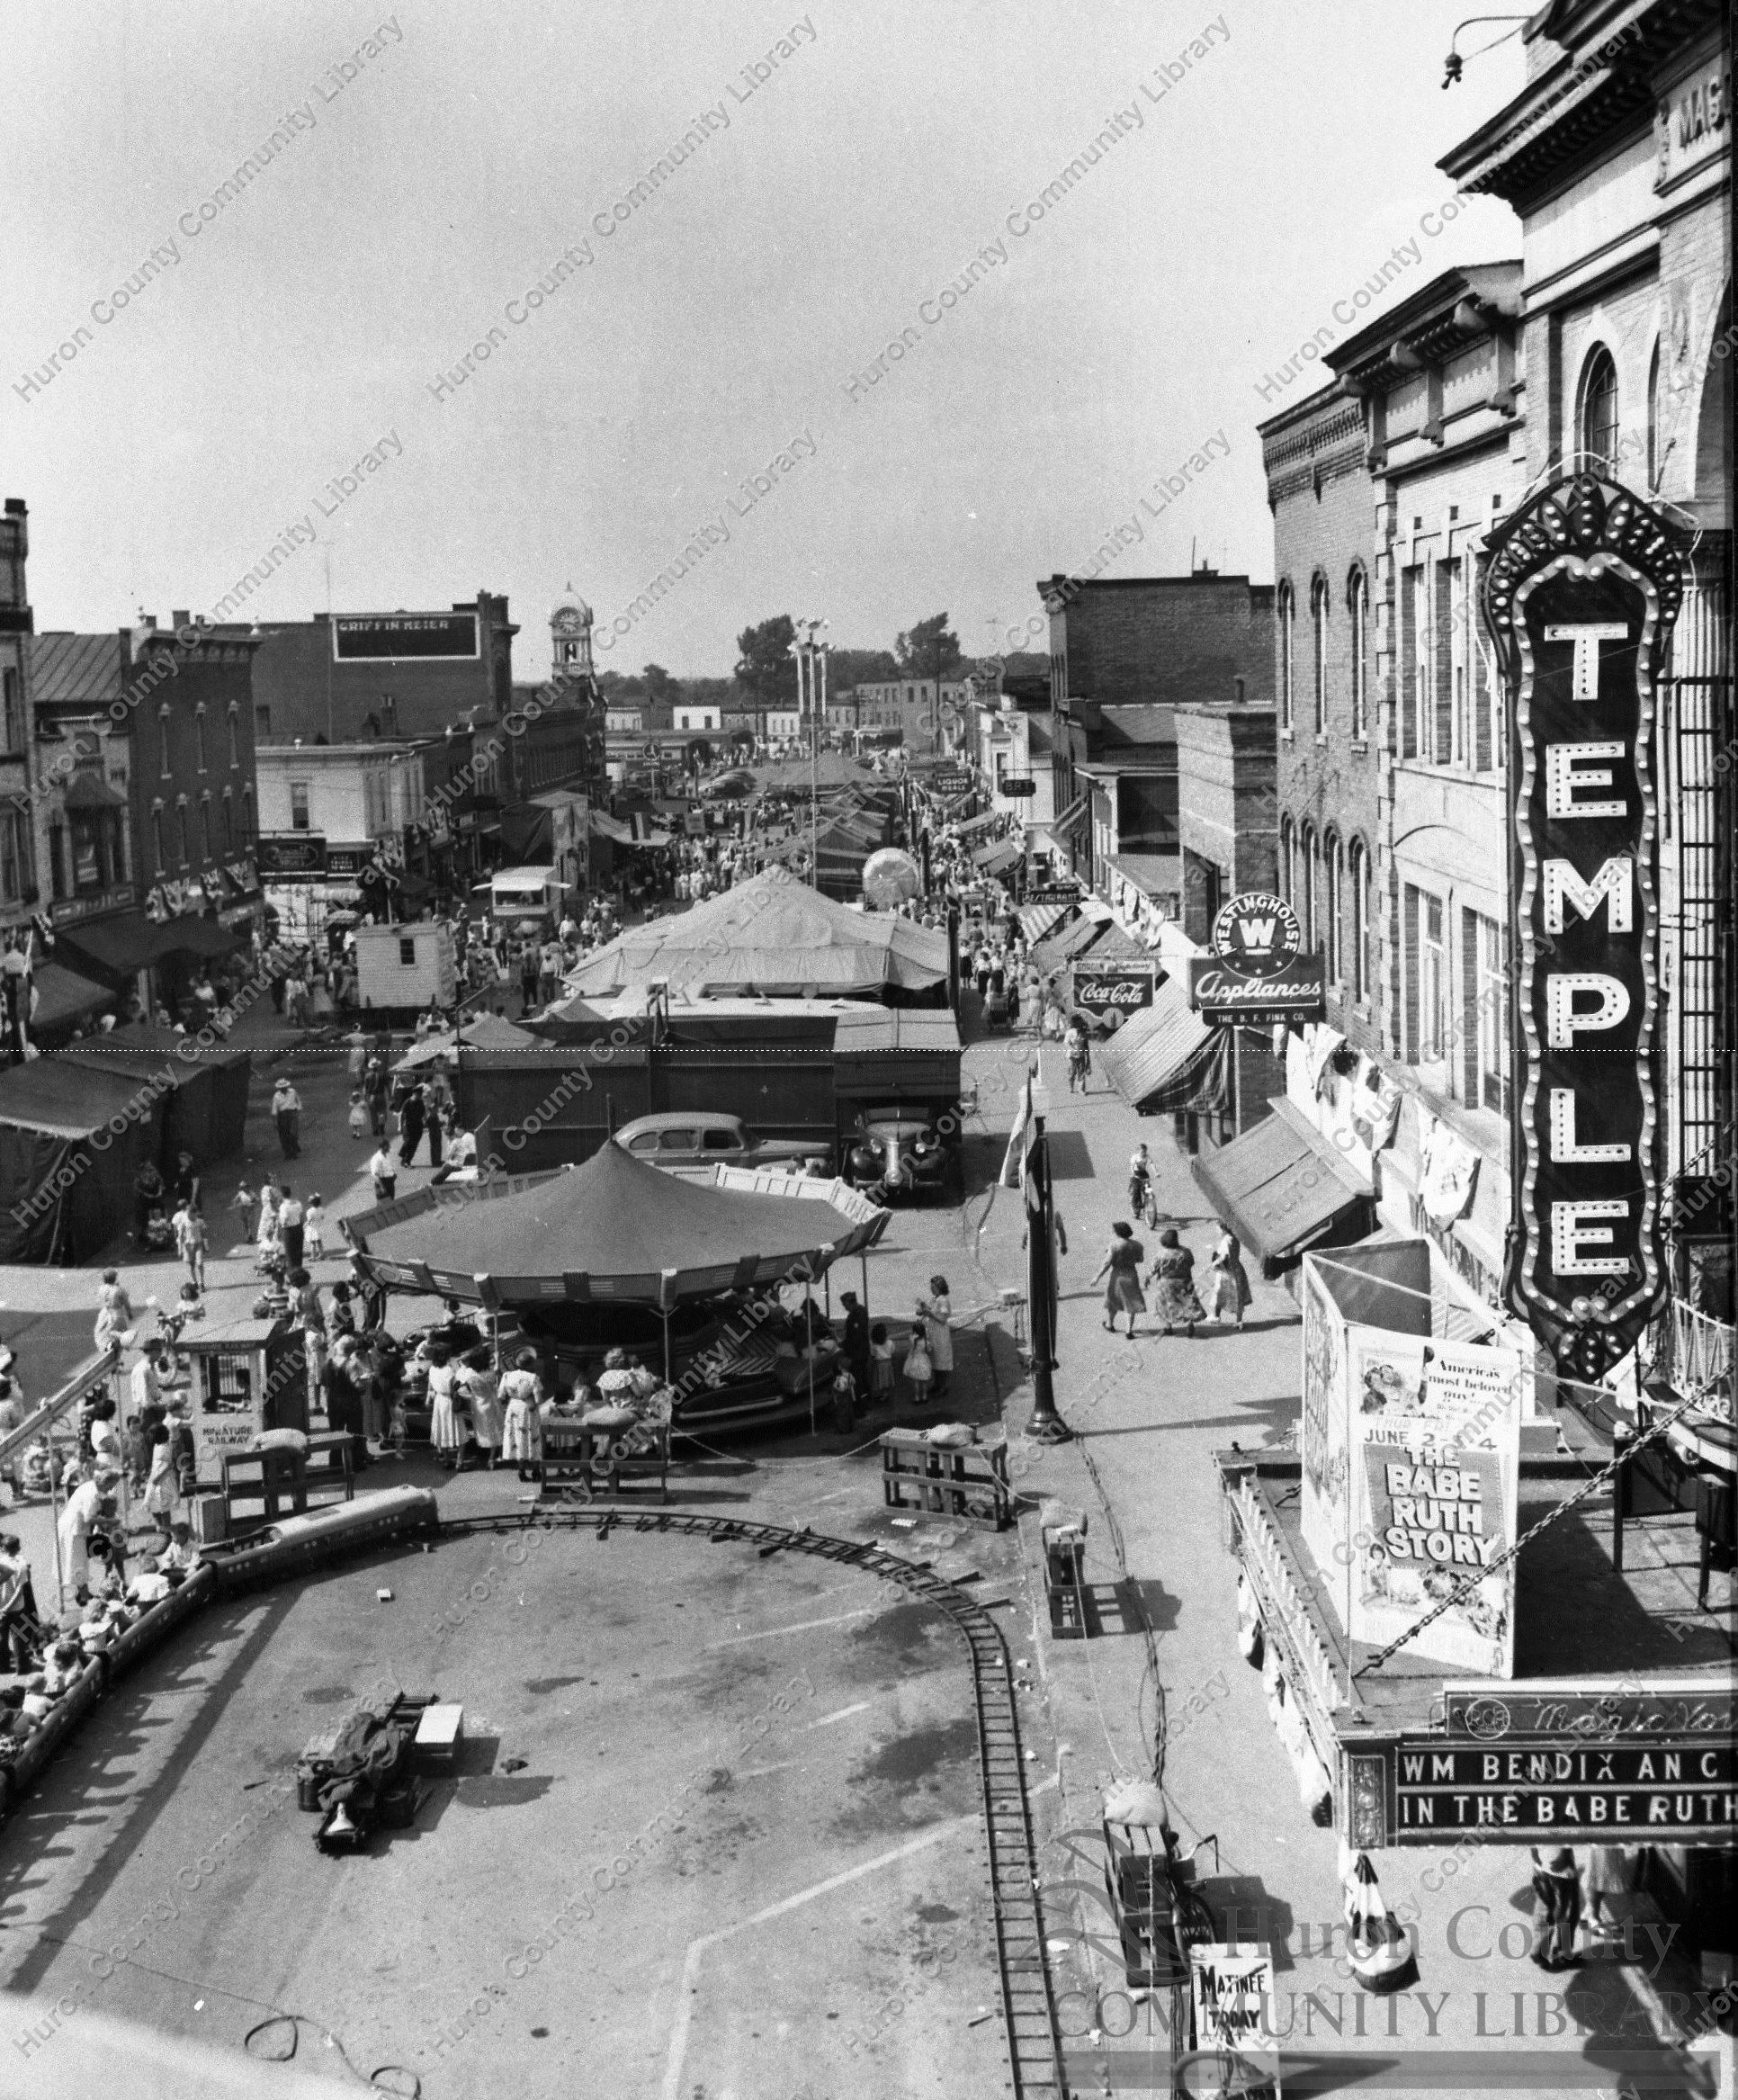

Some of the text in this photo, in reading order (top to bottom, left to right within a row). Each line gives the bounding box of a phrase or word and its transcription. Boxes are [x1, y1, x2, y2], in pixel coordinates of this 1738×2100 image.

[1217, 895, 1300, 956] WESTINGHOUSE
[1238, 918, 1277, 947] W
[1543, 622, 1633, 1275] TEMPLE
[1080, 983, 1147, 1004] Coca-Cola
[1195, 970, 1321, 1005] Appliances
[1216, 1014, 1234, 1024] THE
[1292, 1012, 1307, 1022] CO.
[1439, 1360, 1501, 1379] America's
[1429, 1375, 1513, 1395] most beloved
[202, 1425, 253, 1436] MINIATURE
[1364, 1429, 1410, 1445] JUNE
[1404, 1445, 1461, 1468] THE
[1384, 1463, 1483, 1503] BABE
[1390, 1497, 1483, 1535] RUTH
[1384, 1526, 1501, 1567] STORY
[1402, 1754, 1455, 1781] WM
[1483, 1754, 1616, 1781] BENDIX
[1402, 1793, 1738, 1824] IN THE BABE RUTH
[1198, 1965, 1266, 2006] MATINEE
[1208, 2009, 1261, 2029] TODAY
